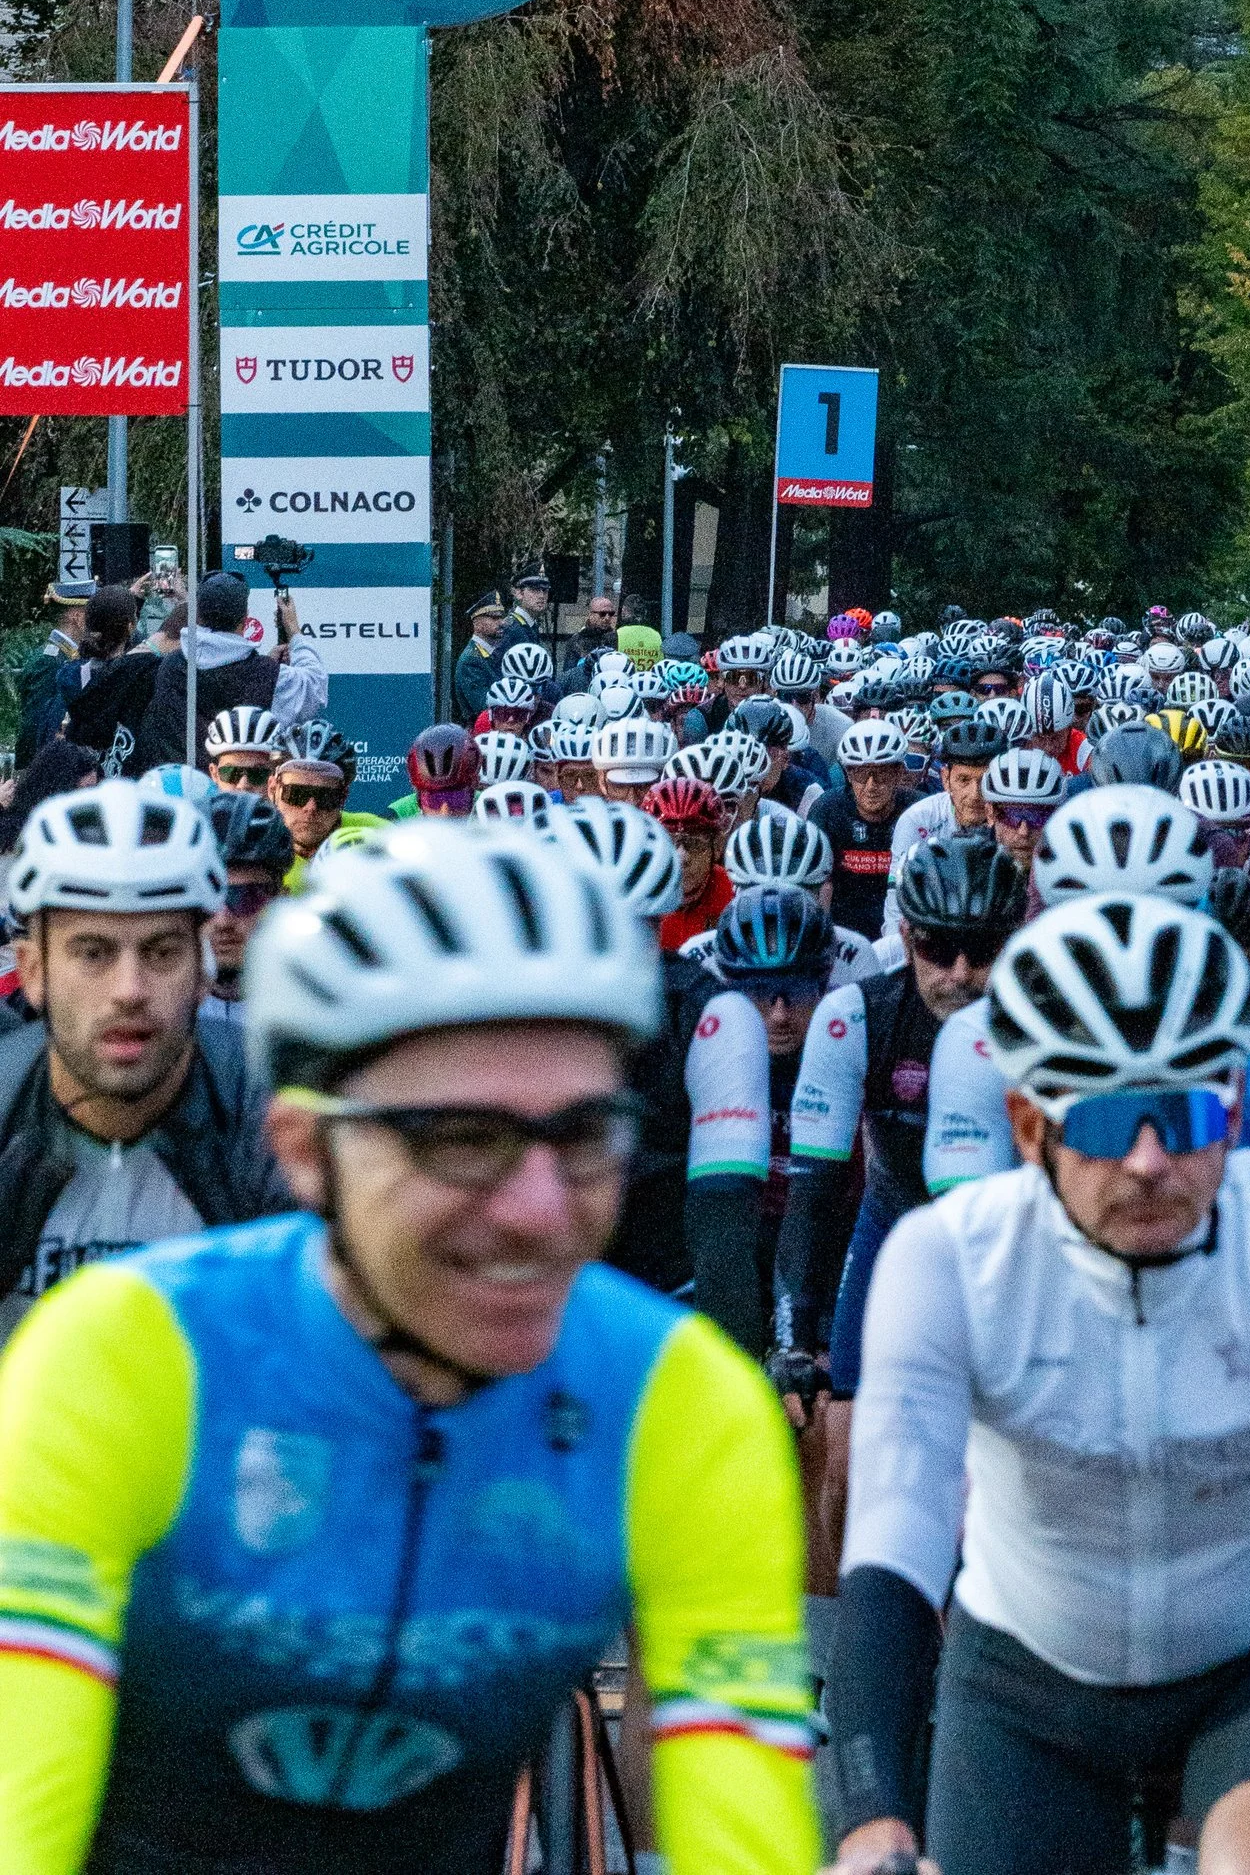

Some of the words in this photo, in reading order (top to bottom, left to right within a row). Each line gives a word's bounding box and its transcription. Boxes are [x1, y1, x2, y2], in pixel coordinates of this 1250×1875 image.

[290, 221, 376, 239] CRÉDIT
[290, 240, 410, 256] AGRICOLE
[266, 358, 384, 381] TUDOR
[818, 392, 841, 455] 1
[269, 490, 416, 513] COLNAGO
[302, 622, 419, 639] ASTELLI
[352, 741, 368, 754] CI
[357, 756, 408, 765] DERAZION
[355, 765, 400, 774] CLISTICA
[353, 773, 393, 783] ALIANA
